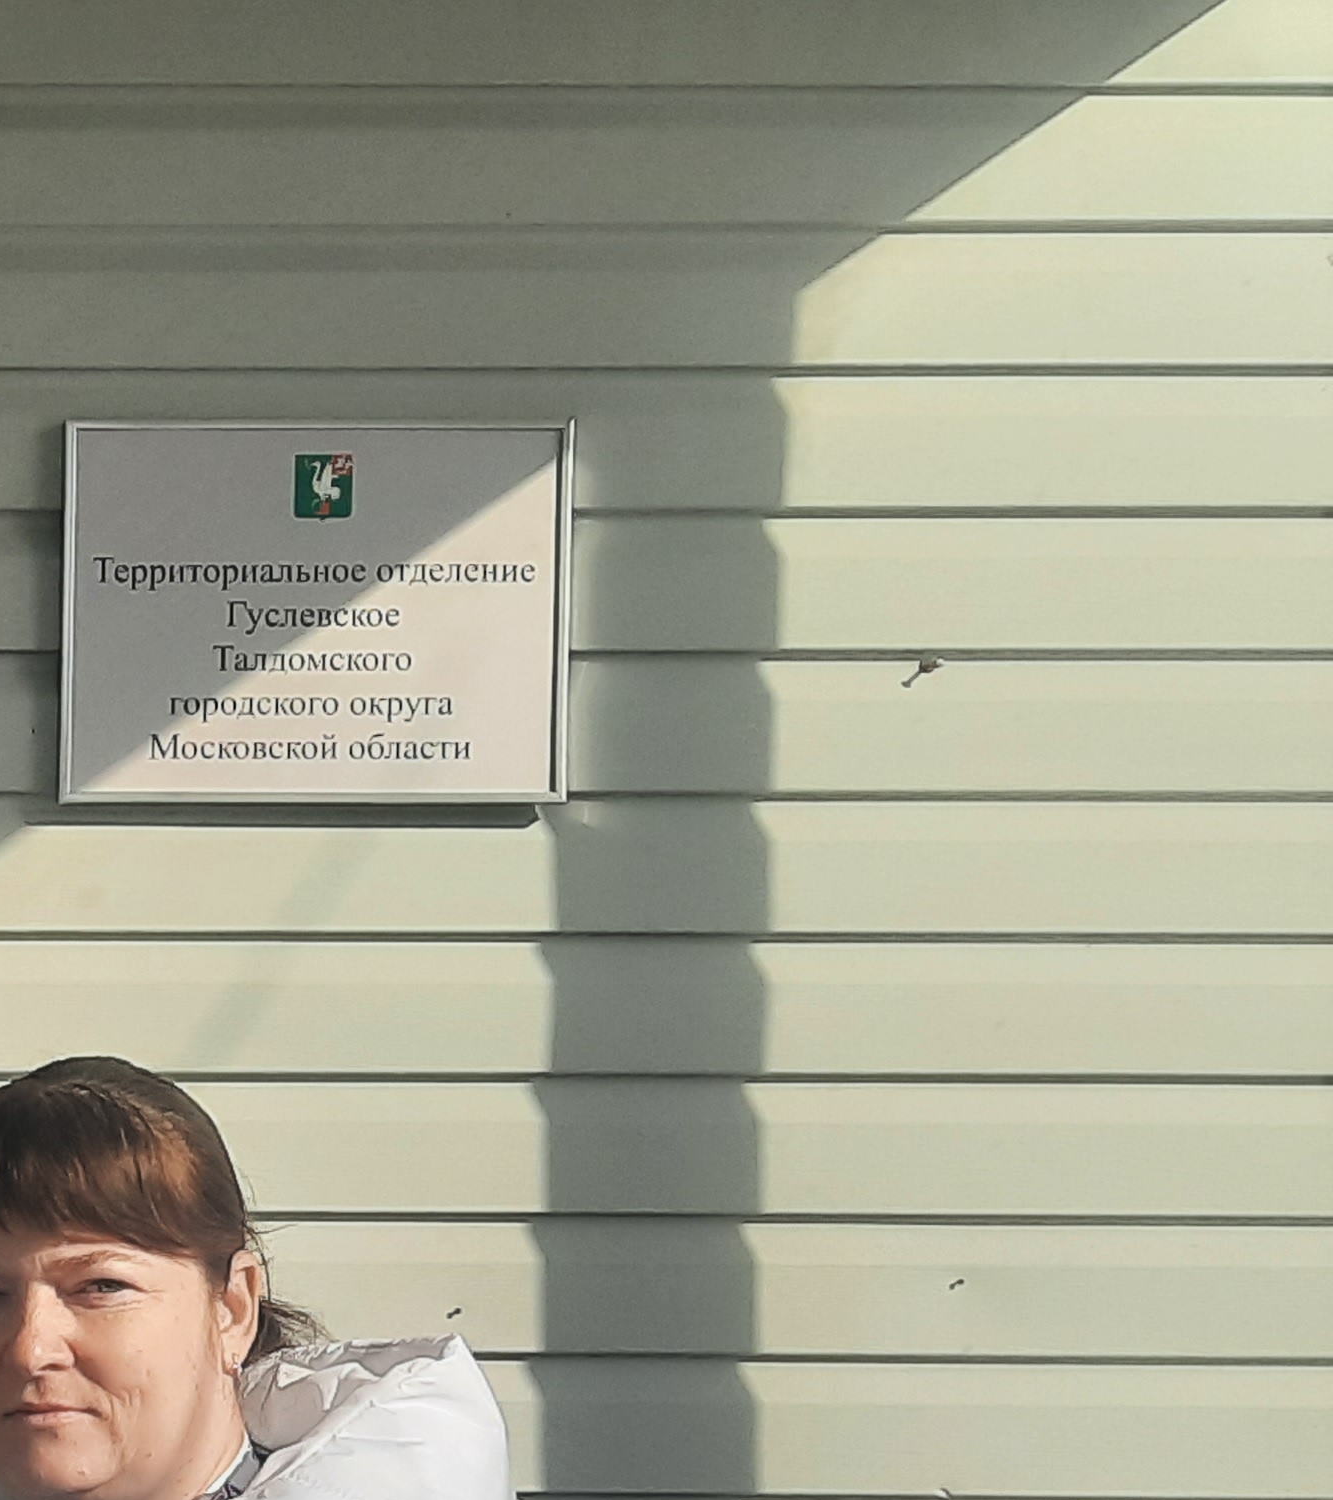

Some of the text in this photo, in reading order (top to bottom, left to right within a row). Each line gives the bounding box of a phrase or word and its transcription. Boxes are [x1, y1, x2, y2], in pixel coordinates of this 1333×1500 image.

[93, 557, 536, 590] Территориальное отделение
[227, 601, 400, 635] Гуслевское
[213, 645, 412, 673] Талдомского
[169, 697, 453, 723] городского округа
[148, 733, 472, 761] Московской области
